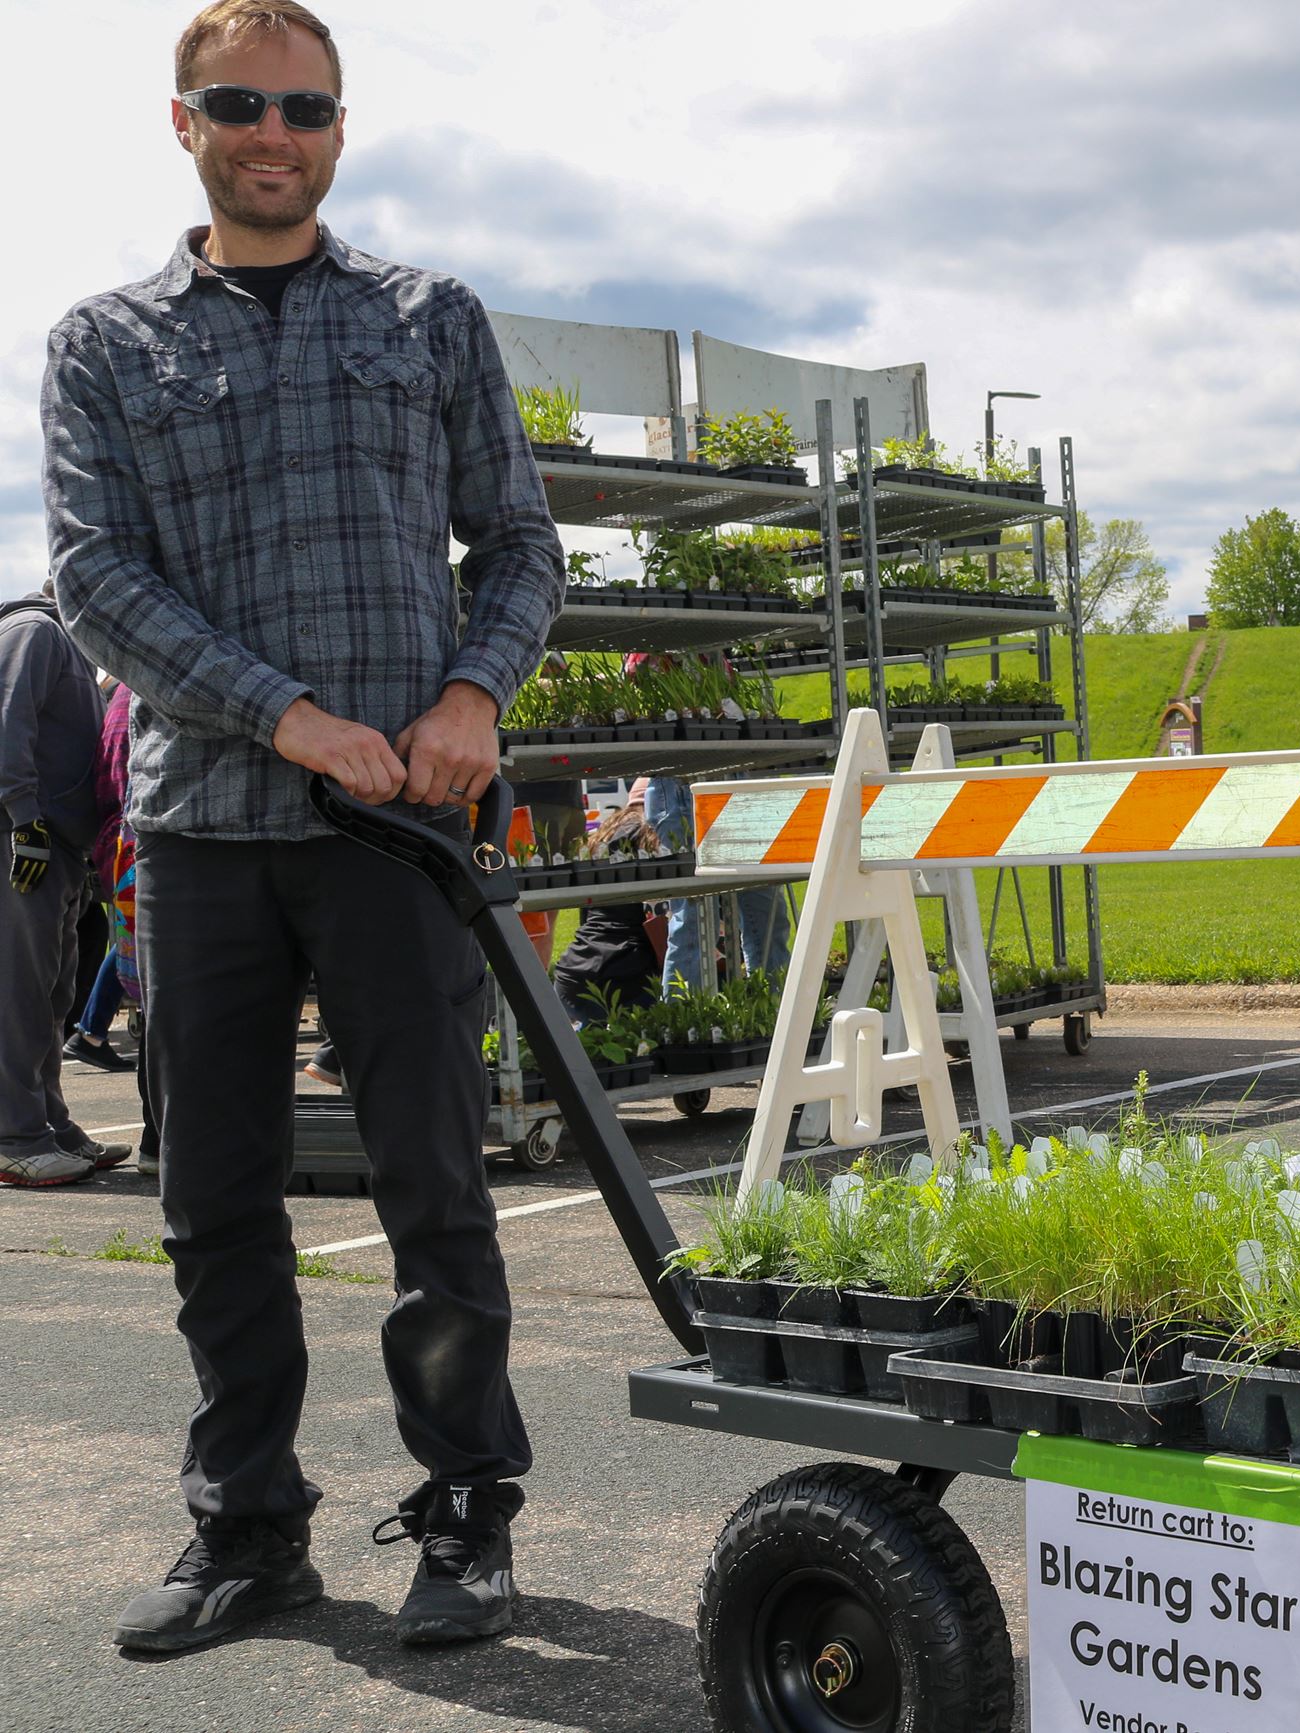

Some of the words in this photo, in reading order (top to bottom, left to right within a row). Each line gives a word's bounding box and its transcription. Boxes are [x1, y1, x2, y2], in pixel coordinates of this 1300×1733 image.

[461, 1490, 469, 1520] Reebok
[1077, 1492, 1153, 1529] Return
[1163, 1509, 1214, 1538] cart
[1221, 1516, 1254, 1546] to:
[1040, 1542, 1192, 1624] Blazing
[1210, 1572, 1299, 1632] Star
[1070, 1621, 1263, 1701] Gardens
